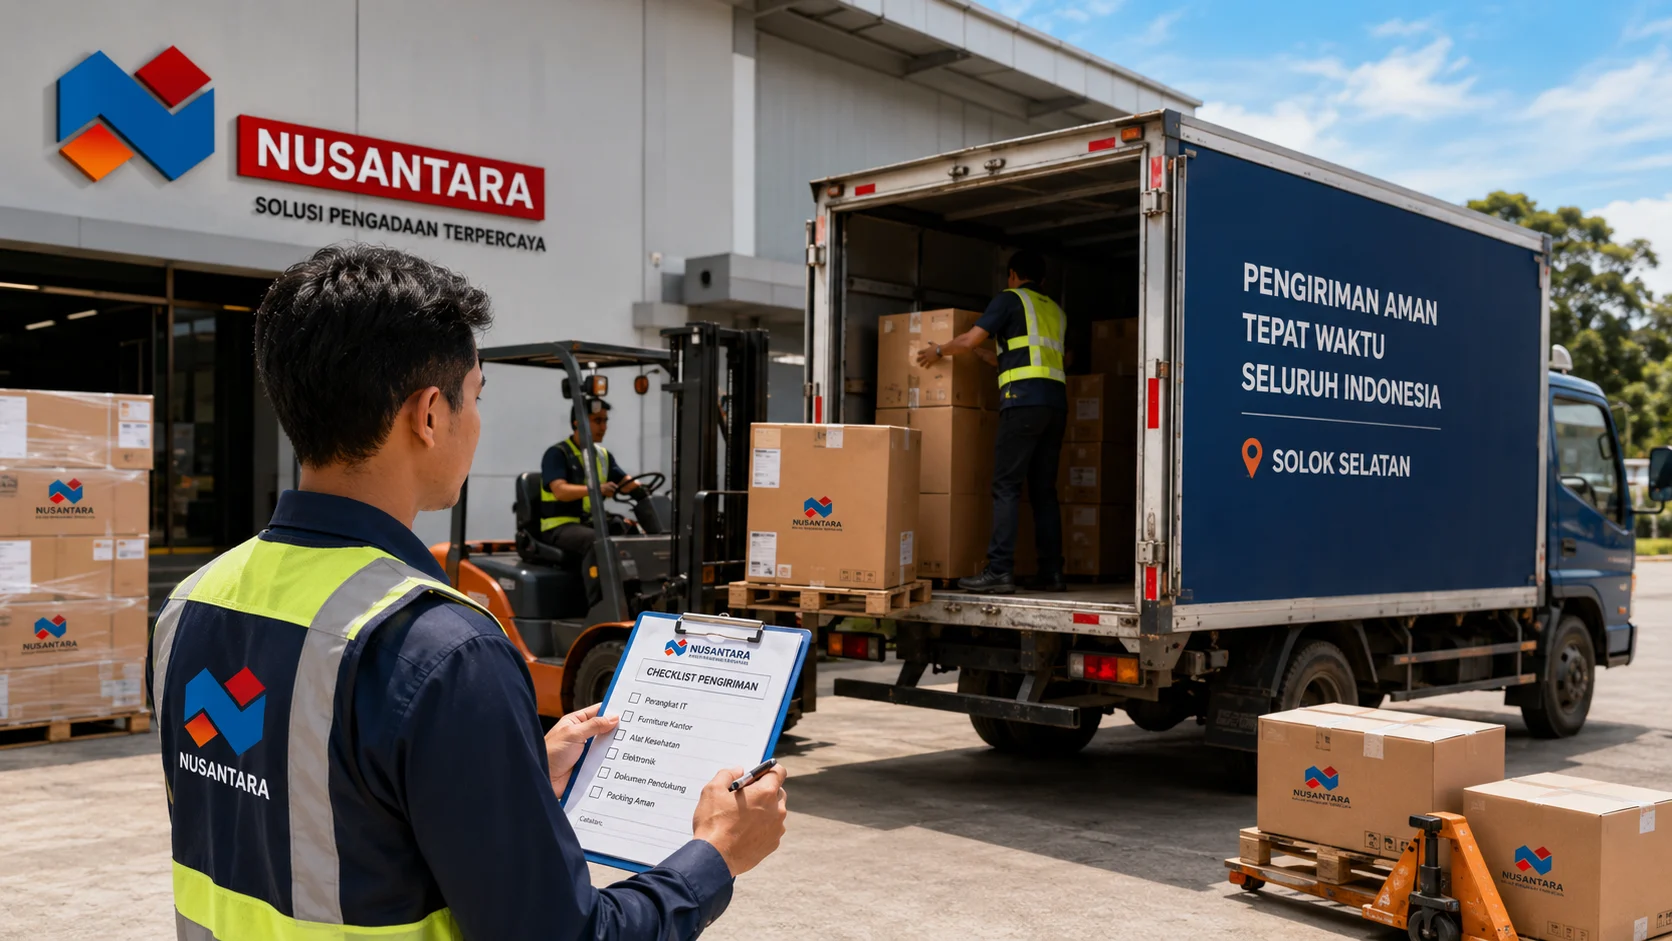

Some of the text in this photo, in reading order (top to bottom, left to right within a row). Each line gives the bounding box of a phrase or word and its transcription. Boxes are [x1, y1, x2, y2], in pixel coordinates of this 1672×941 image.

[257, 128, 534, 209] NUSANTARA
[255, 196, 546, 252] SOLUSI PENGADAAN TERPERCAYA
[1243, 262, 1438, 326] PENGIRIMAN AMAN
[1242, 313, 1385, 359] TEPAT WAKTU
[1241, 362, 1442, 409] SELURUH INDONESIA
[1272, 449, 1411, 477] SOLOK SELATAN
[36, 506, 94, 514] NUSANTARA
[792, 519, 842, 527] NUSANTARA
[23, 640, 77, 649] NUSANTARA
[689, 644, 751, 660] NUSANTARA
[646, 667, 759, 691] CHECKLIST PENGIRIMAN
[645, 696, 679, 709] Perangkat
[638, 716, 693, 731] Furniture Kantor
[629, 734, 680, 749] Alat Kesehatan
[179, 751, 270, 800] NUSANTARA
[614, 771, 687, 793] Dokumen Pendukung
[606, 791, 655, 808] Packing Aman
[1293, 789, 1350, 804] NUSANTARA
[1502, 870, 1564, 892] NUSANTARA
